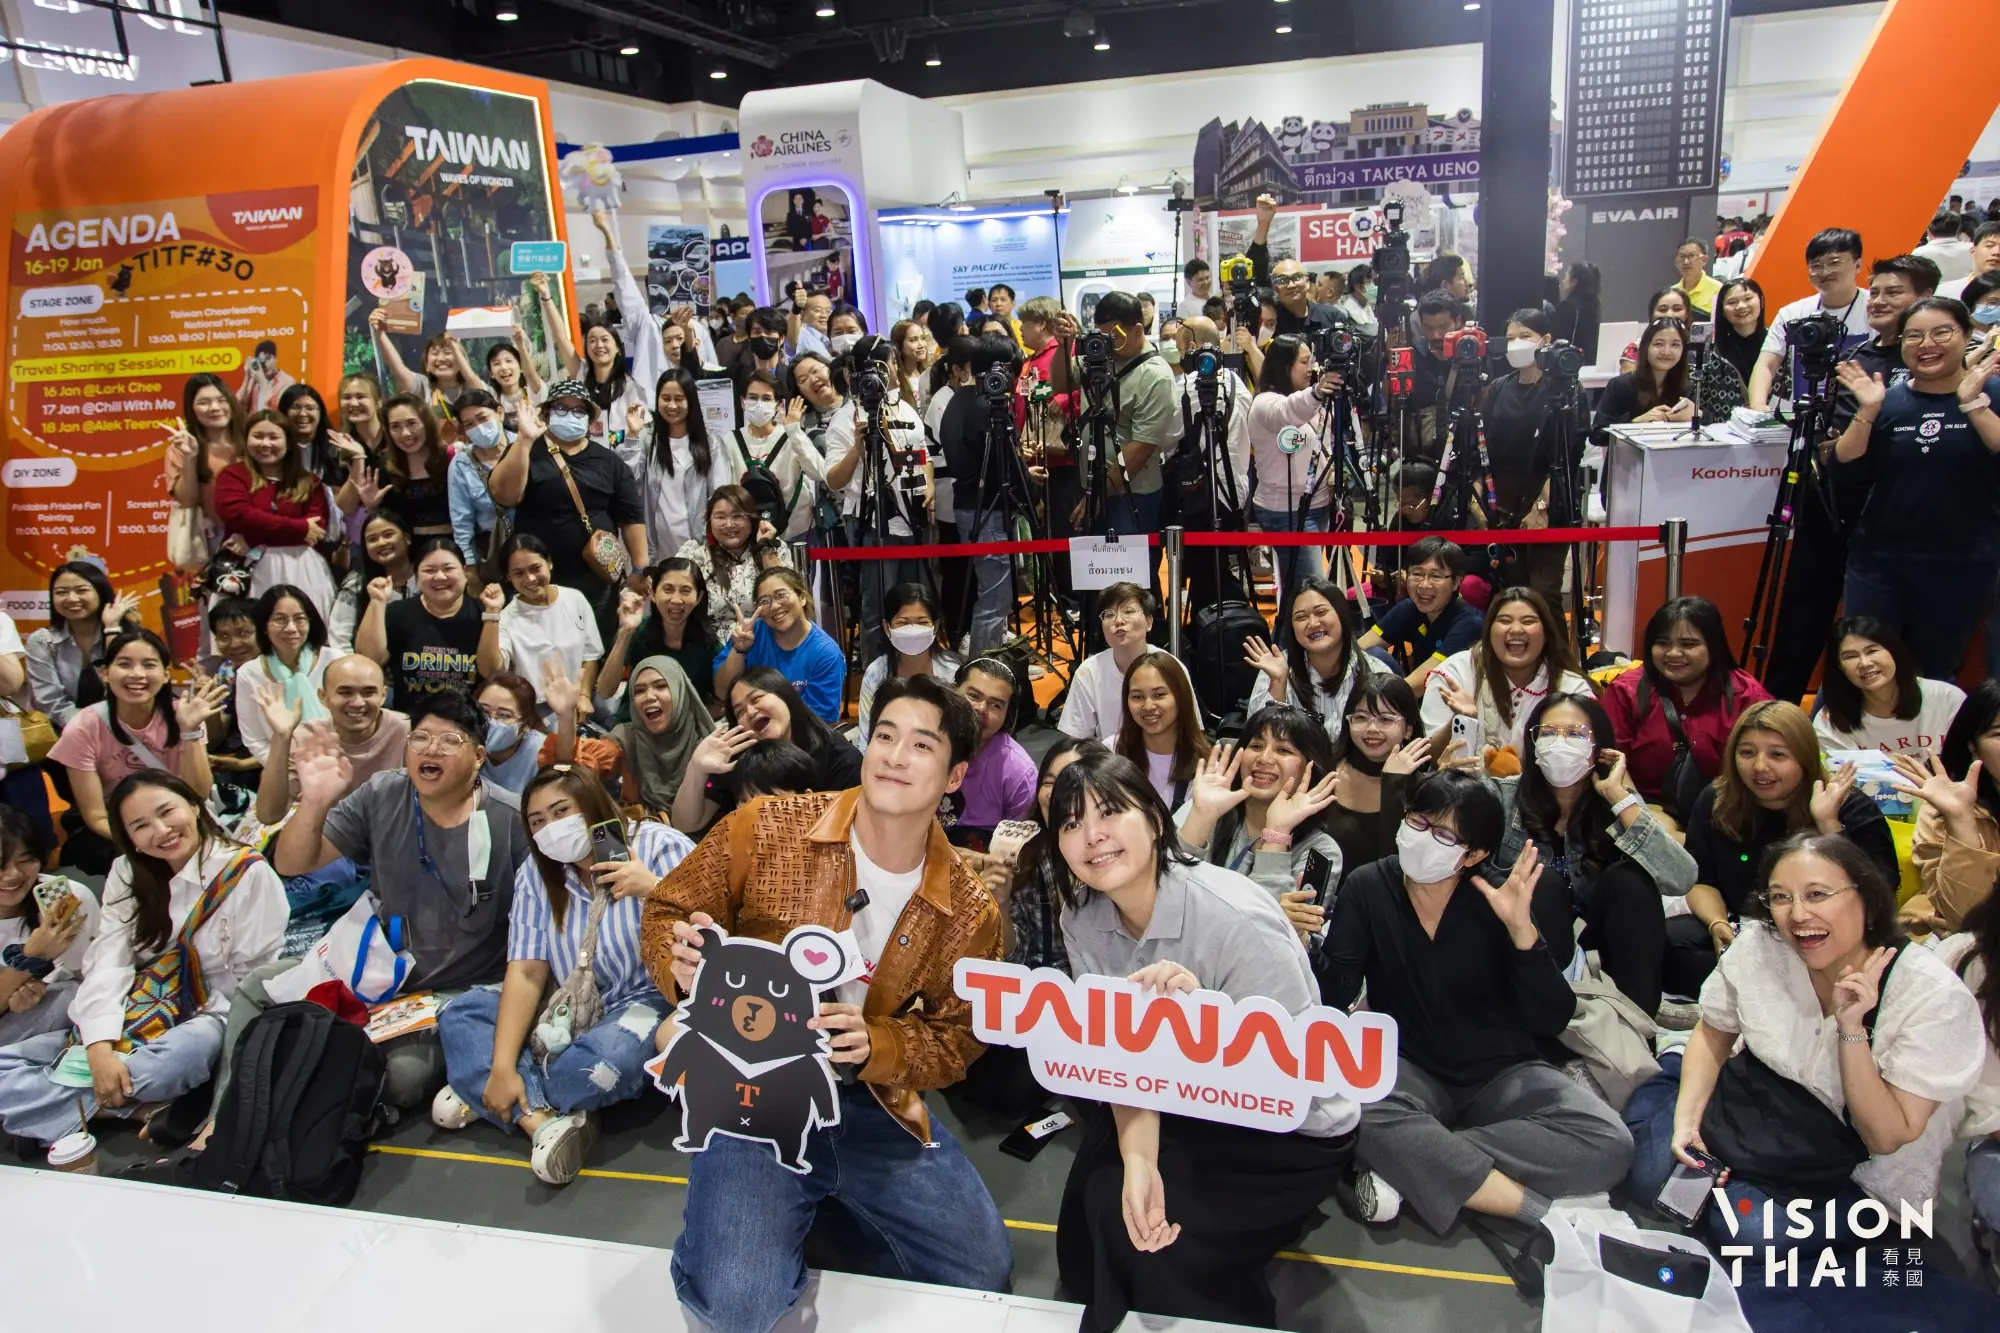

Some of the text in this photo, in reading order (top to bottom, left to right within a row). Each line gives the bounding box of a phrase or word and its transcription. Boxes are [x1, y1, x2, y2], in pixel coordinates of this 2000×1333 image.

[1582, 4, 1623, 18] OSAKA
[1582, 10, 1712, 32] LONDON LHR
[1581, 24, 1711, 45] AMSTERDAM AMS
[1581, 38, 1710, 60] VIENNA VIE
[1580, 52, 1709, 72] PARIS CDG
[1579, 66, 1708, 86] MILAN MXP
[1579, 80, 1708, 100] LOS ANGELES LAX
[1578, 93, 1707, 113] SAN FRANCISCO SFO
[1578, 107, 1706, 127] SEATTLE SEA
[780, 129, 825, 144] CHINA
[1577, 134, 1704, 153] CHICAGO ORD
[405, 125, 530, 171] TAIWAN
[774, 140, 832, 156] AIRLINES
[1576, 148, 1703, 166] HOUSTON IAH
[1304, 167, 1355, 187] ตึกม่วง
[1361, 160, 1480, 182] TAKEYA UENO
[1576, 161, 1702, 179] VANCOUVER YVR
[440, 173, 514, 188] WAVES OF WONDER
[1576, 174, 1702, 192] TORONTO YYZ
[232, 206, 303, 224] TAIWAN
[25, 212, 181, 253] AGENDA
[24, 257, 103, 275] 16-19 Jan
[132, 245, 254, 281] TITF#30
[952, 266, 969, 274] SKY
[971, 262, 1010, 273] PACIFIC
[29, 295, 94, 308] STAGE ZONE
[170, 305, 267, 319] Taiwan Cheerleading
[184, 318, 250, 329] National Team
[237, 328, 265, 339] Stage
[14, 352, 233, 377] Travel Sharing Session 14:00
[43, 386, 57, 398] 16
[58, 385, 81, 397] Jan
[83, 382, 125, 397] @Lark
[42, 398, 176, 416] 17 Jan @Chill With Me
[58, 421, 80, 433] Jan
[13, 468, 61, 478] DIY ZONE
[127, 500, 158, 509] Screen
[1088, 561, 1133, 575] สื่อมวลชน
[7, 601, 38, 610] FOOD
[402, 651, 477, 672] DRINK
[965, 972, 1383, 1089] TAIWAN
[735, 1082, 760, 1108] T
[1044, 1060, 1295, 1119] WAVES OF WONDER
